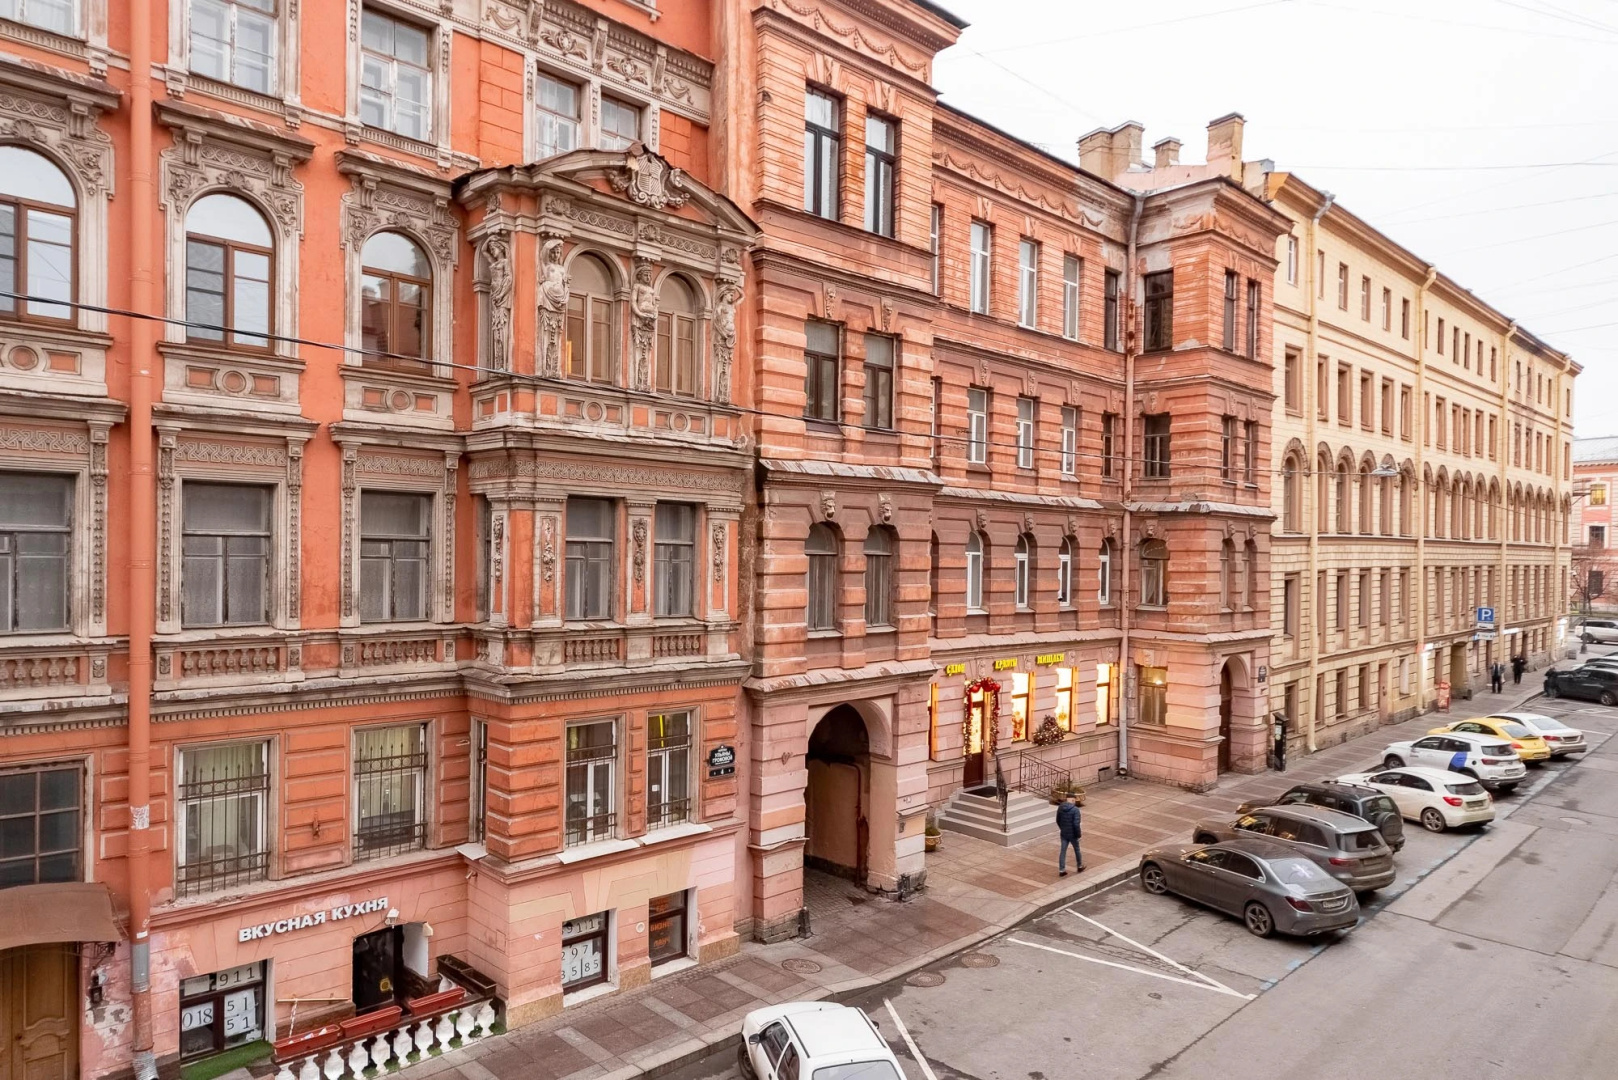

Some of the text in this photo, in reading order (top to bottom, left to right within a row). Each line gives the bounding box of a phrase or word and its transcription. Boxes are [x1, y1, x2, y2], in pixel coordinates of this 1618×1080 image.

[1481, 608, 1492, 621] P
[238, 896, 389, 943] ВКУСНАЯ КУХНЯ
[219, 966, 255, 987] 911
[182, 1007, 213, 1028] 018
